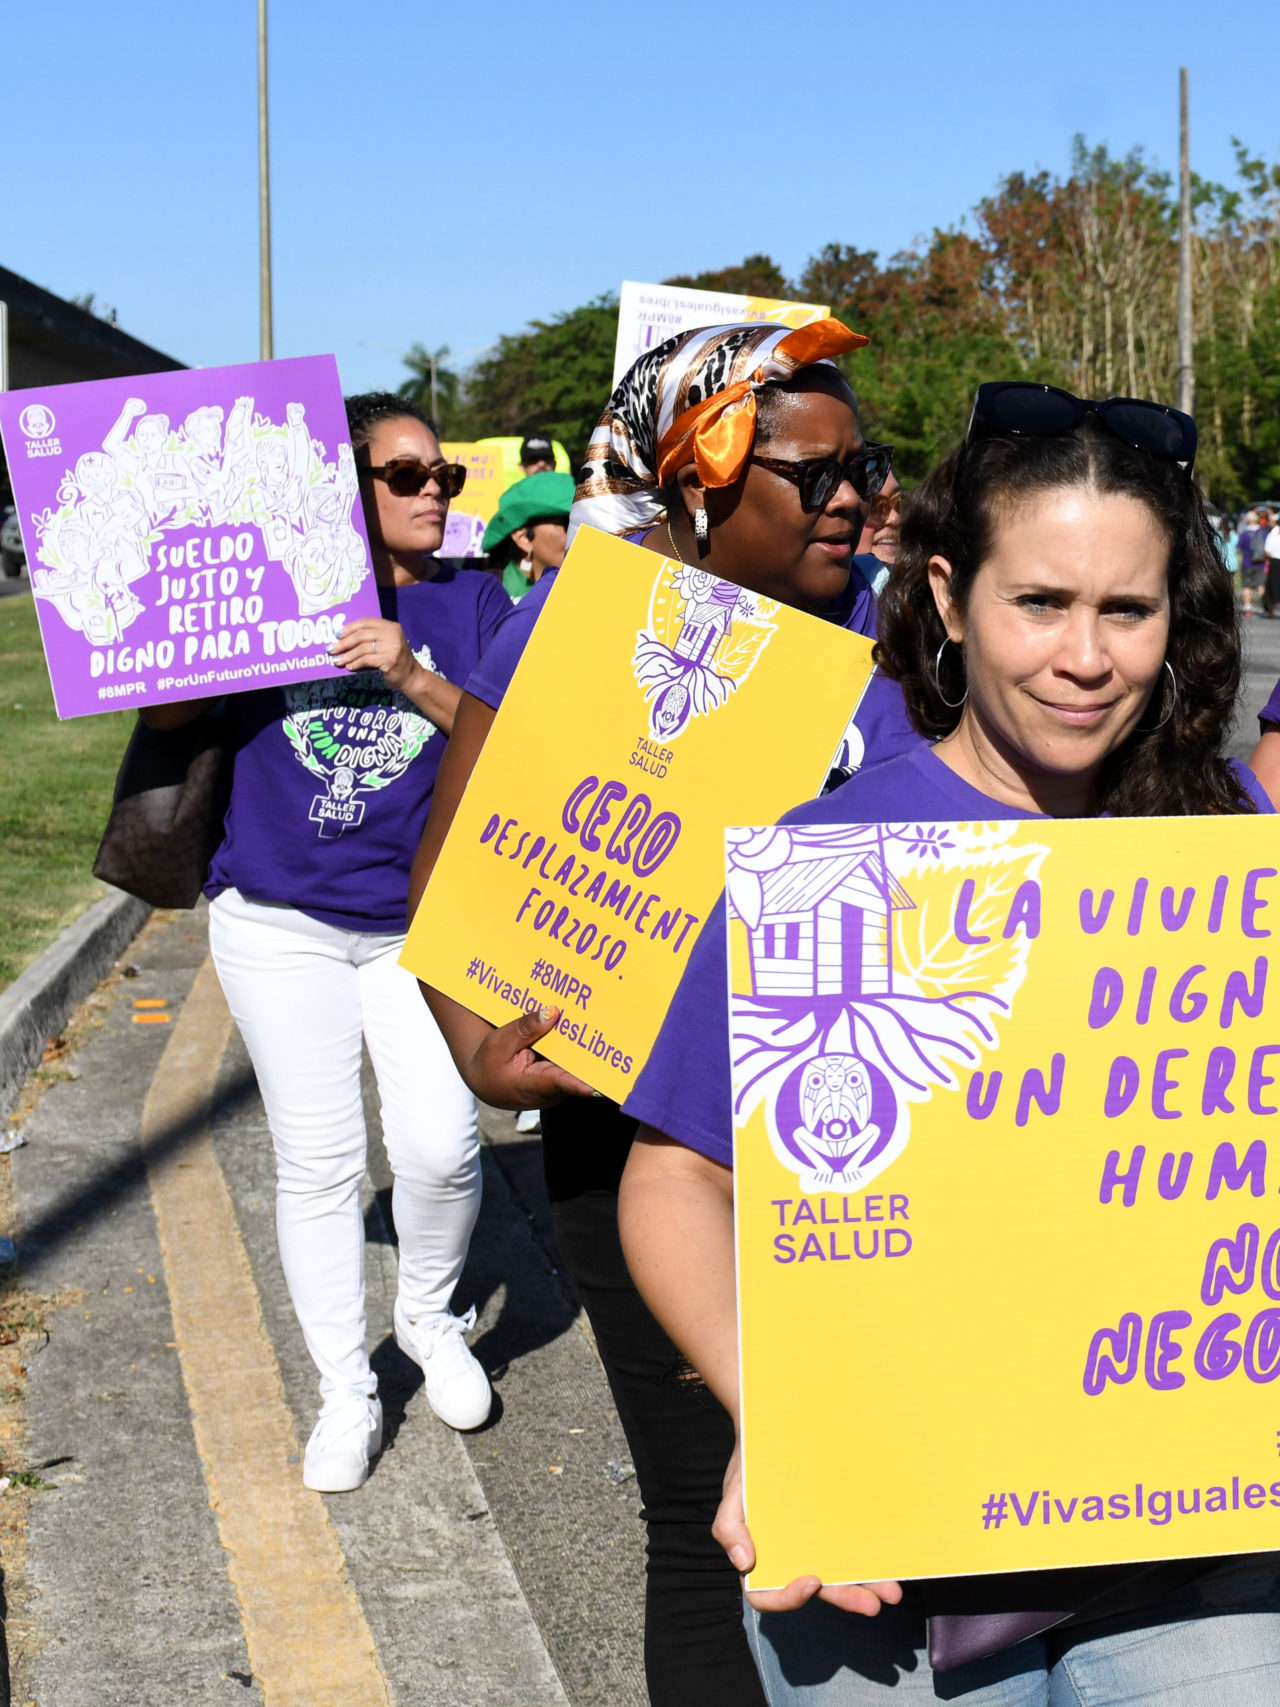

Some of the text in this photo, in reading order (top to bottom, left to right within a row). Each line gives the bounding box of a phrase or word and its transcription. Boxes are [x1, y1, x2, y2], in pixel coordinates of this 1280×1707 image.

[25, 438, 60, 450] TALLER
[27, 447, 62, 458] SALUD
[155, 532, 254, 572] SUELDO
[155, 565, 265, 606] JUSTO Y
[169, 595, 264, 635] RETIRO
[90, 640, 175, 678] DIGNO
[184, 629, 250, 666] PARA
[97, 682, 147, 700] #8MPR
[322, 700, 402, 732] FUTURO
[333, 723, 378, 742] Y UNA
[308, 720, 404, 769] VIDA DIGNA
[637, 736, 674, 764] TALLER
[629, 751, 668, 779] SALUD
[318, 808, 354, 822] SALUD
[320, 800, 356, 813] TALLER
[562, 776, 682, 878] CERO
[479, 813, 699, 953] DESPLAZAMIENT
[953, 877, 1043, 945] LA
[515, 887, 627, 981] FORZOSO.
[530, 957, 593, 1011] #8MPR
[466, 956, 634, 1075] #VivasIglesLibres
[965, 1052, 1066, 1127] UN
[772, 1194, 911, 1228] TALLER
[773, 1227, 914, 1265] SALUD
